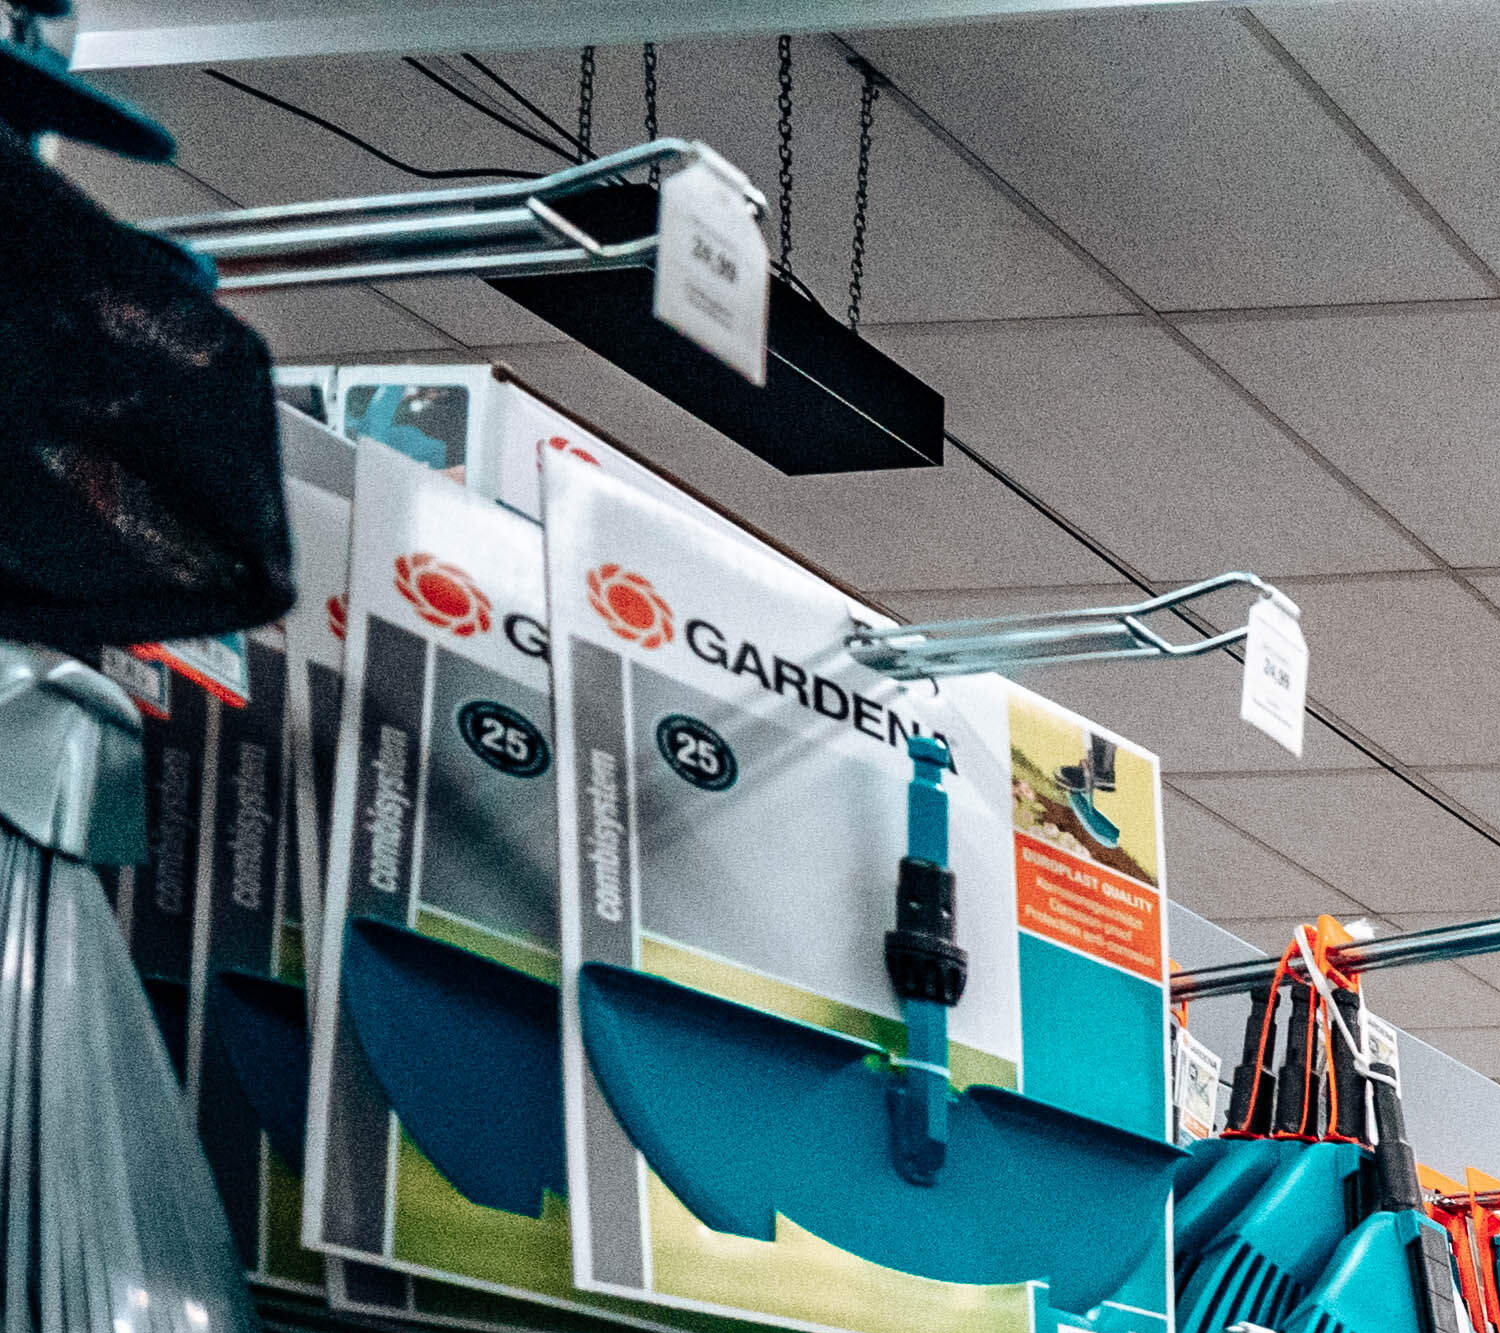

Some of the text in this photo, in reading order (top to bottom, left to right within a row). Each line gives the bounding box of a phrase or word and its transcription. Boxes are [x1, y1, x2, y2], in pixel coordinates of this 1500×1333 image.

[478, 715, 529, 766] 25
[679, 729, 723, 775] 25
[368, 726, 410, 892] combisystem
[594, 750, 622, 922] combisystem
[1102, 882, 1153, 912] QUALITY
